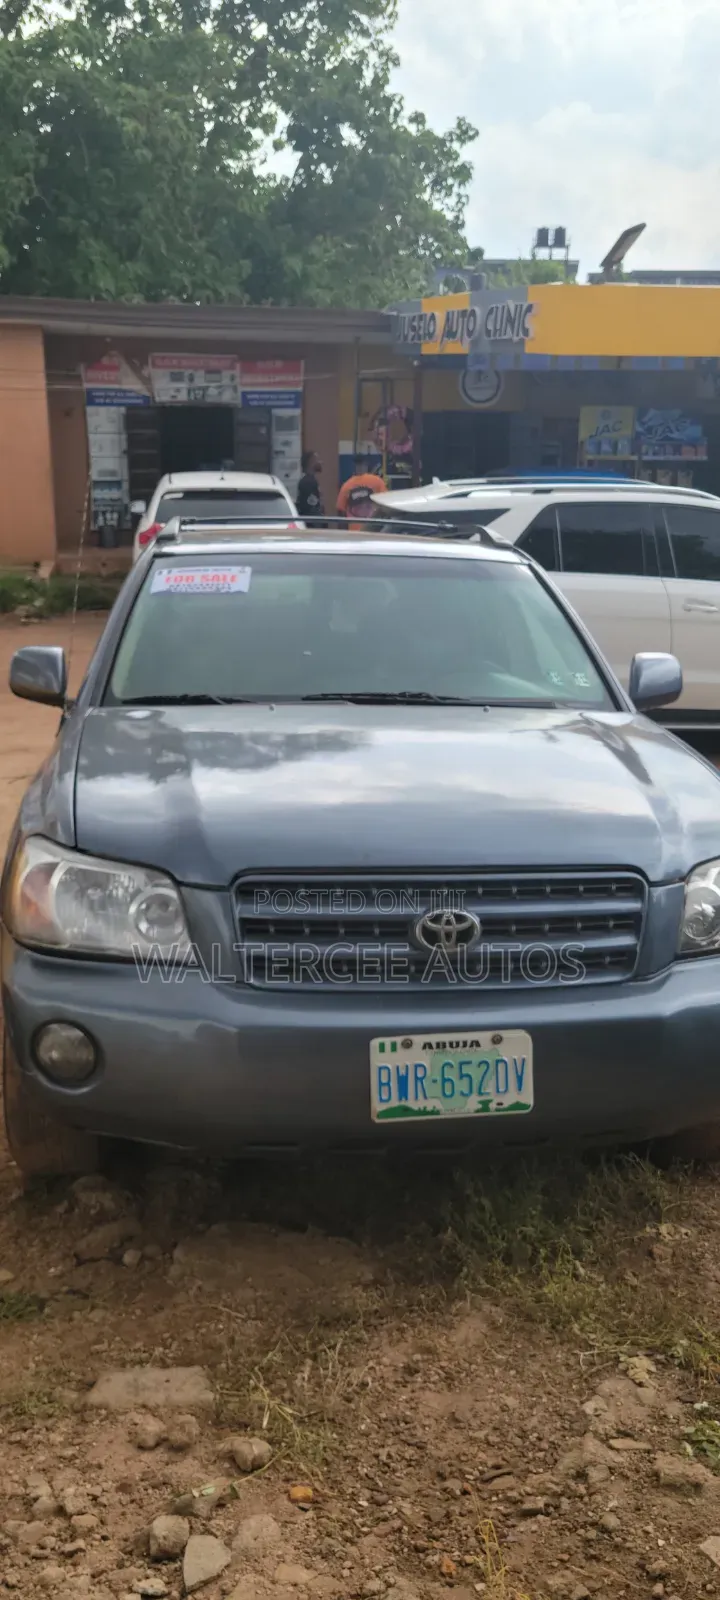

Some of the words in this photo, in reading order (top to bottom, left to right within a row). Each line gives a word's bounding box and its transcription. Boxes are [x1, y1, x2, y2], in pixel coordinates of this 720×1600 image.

[440, 308, 478, 351] AUTO
[484, 301, 534, 341] CLINIC
[422, 1040, 481, 1050] ABUJA
[377, 1056, 526, 1103] BWR-652DV
